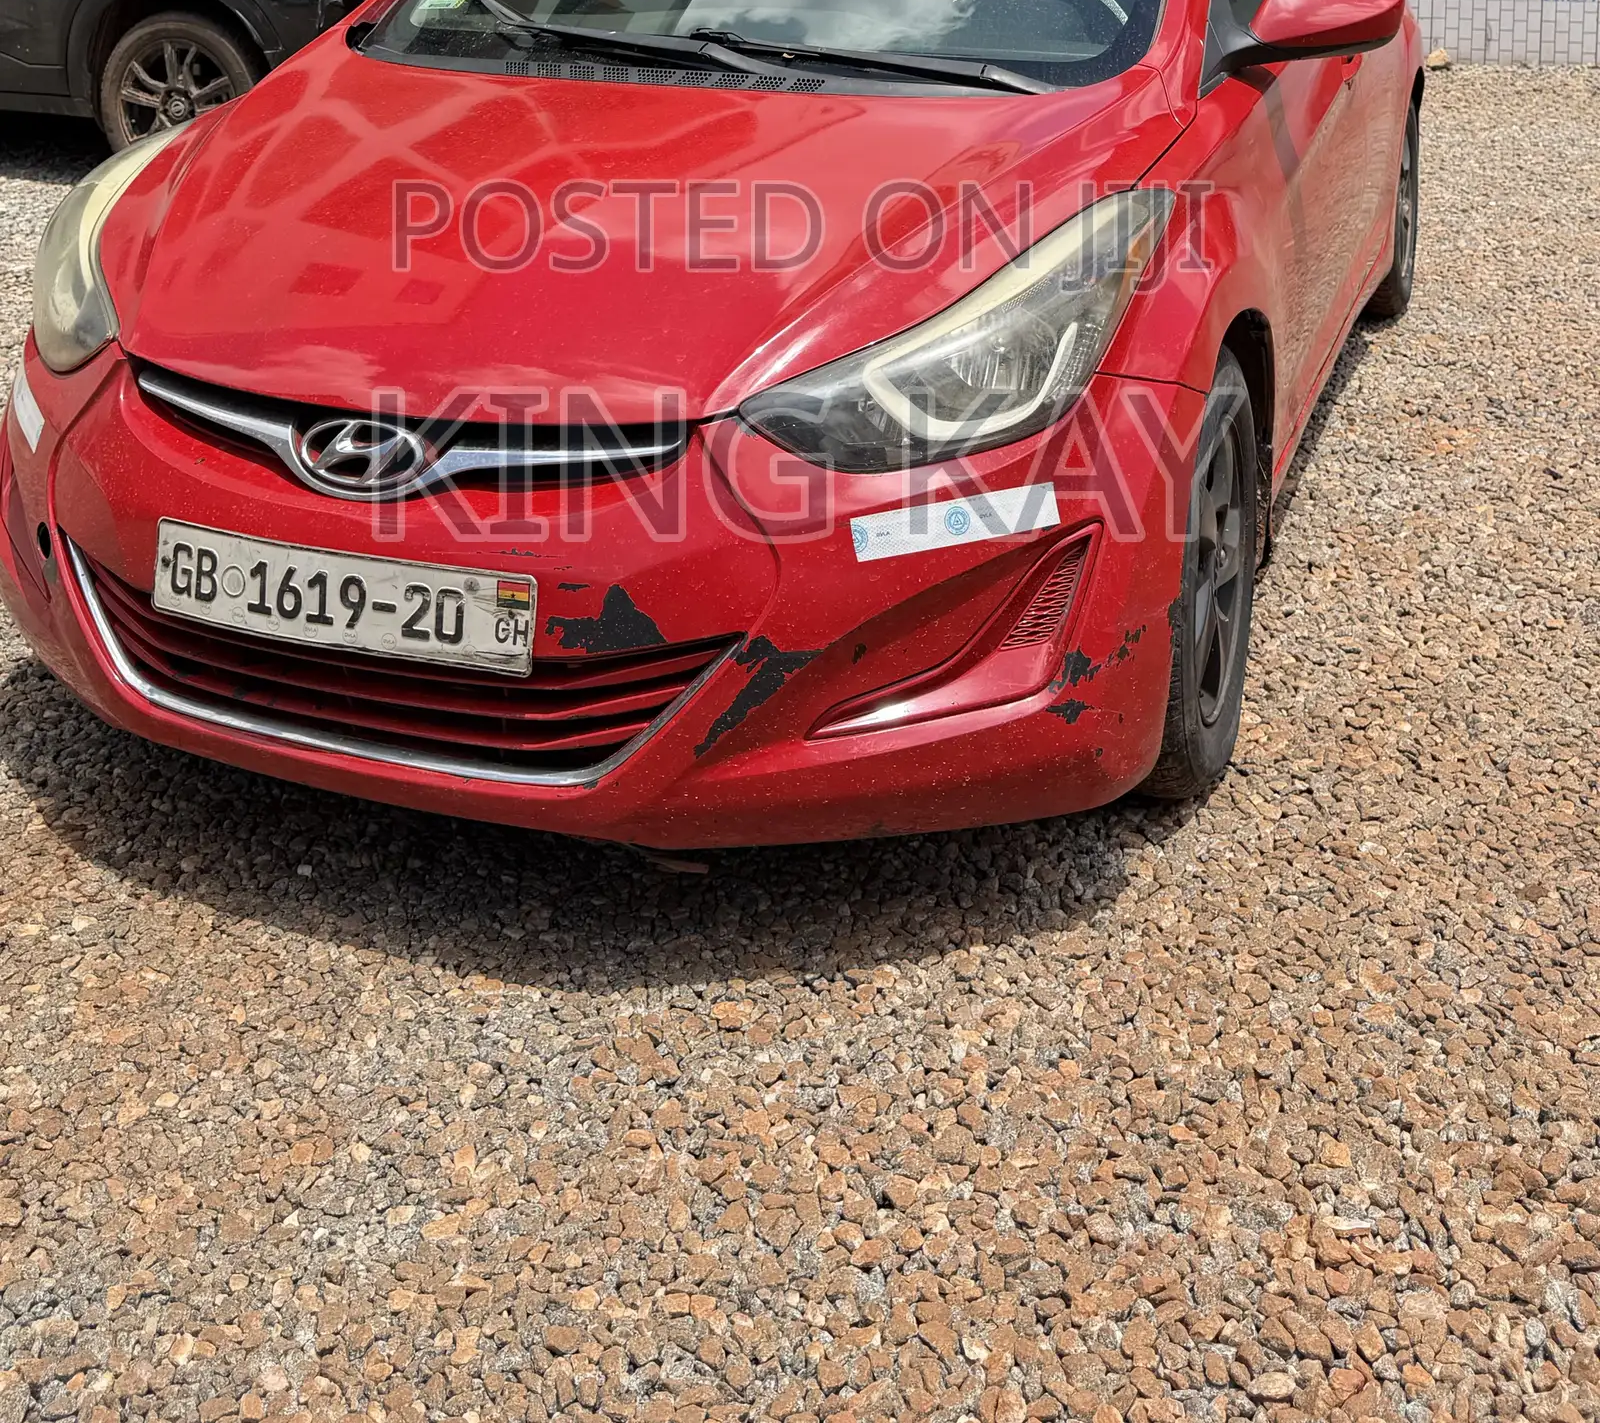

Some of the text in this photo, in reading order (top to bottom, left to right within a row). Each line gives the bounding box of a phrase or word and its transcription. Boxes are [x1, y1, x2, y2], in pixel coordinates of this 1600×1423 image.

[170, 542, 467, 645] GB 1619-20
[493, 617, 530, 647] GH
